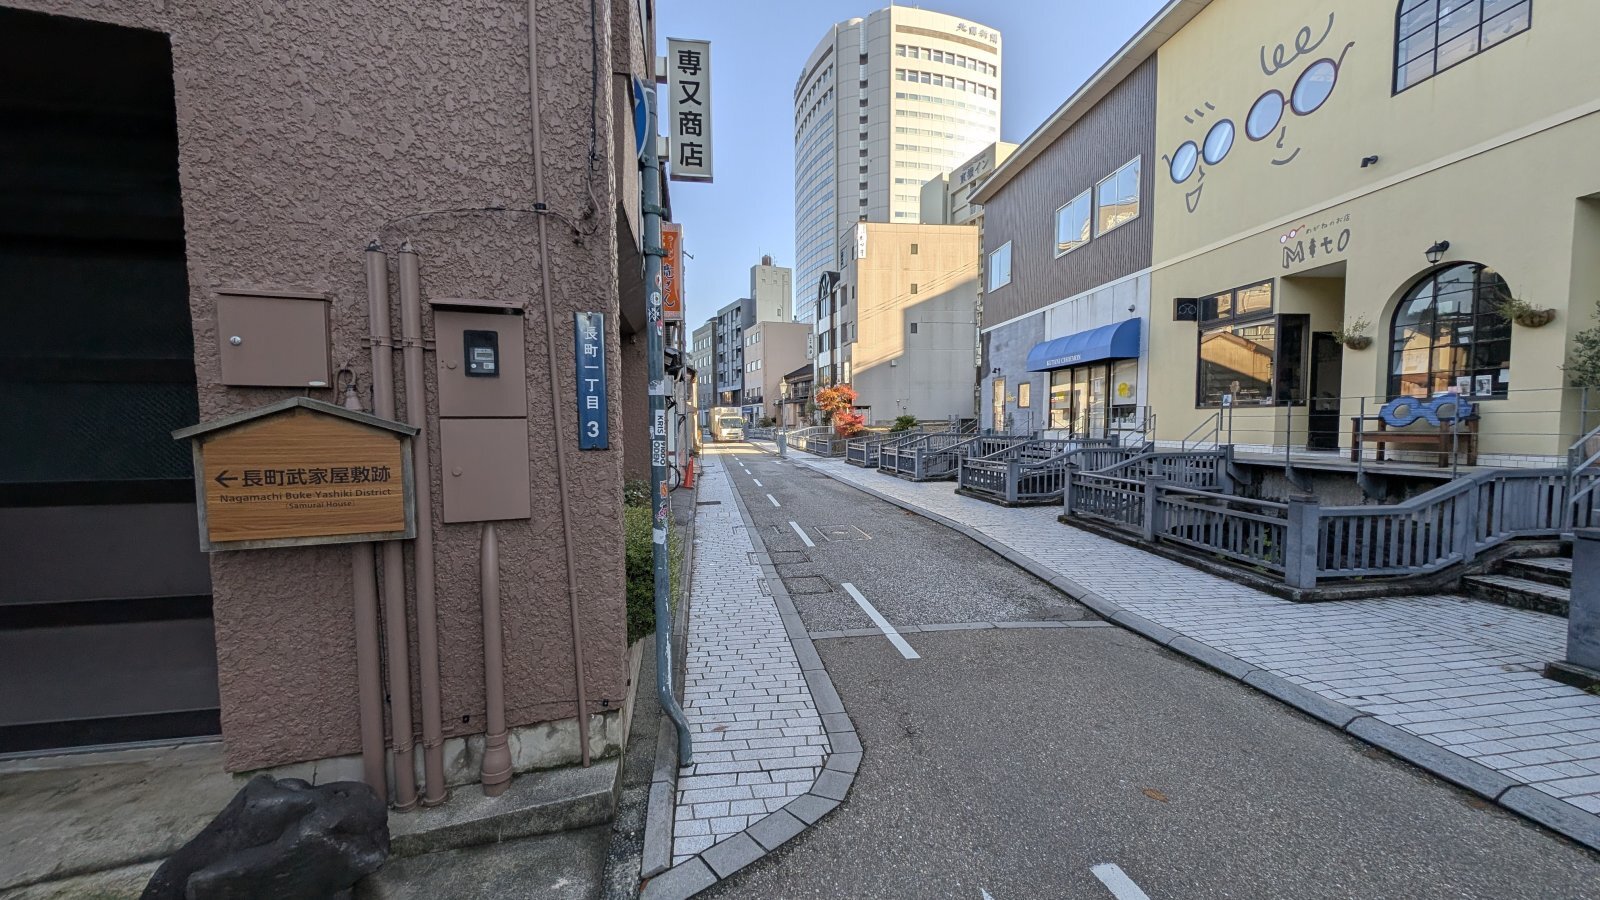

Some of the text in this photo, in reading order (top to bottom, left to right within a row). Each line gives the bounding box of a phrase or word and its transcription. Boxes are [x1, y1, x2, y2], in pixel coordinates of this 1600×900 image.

[677, 49, 703, 168] 専又商店
[584, 326, 600, 438] 長町一丁目 3
[656, 415, 665, 434] KRIS
[242, 466, 391, 487] 長町武家屋敷跡
[220, 488, 392, 504] Nagamachi Buke Yashiki District
